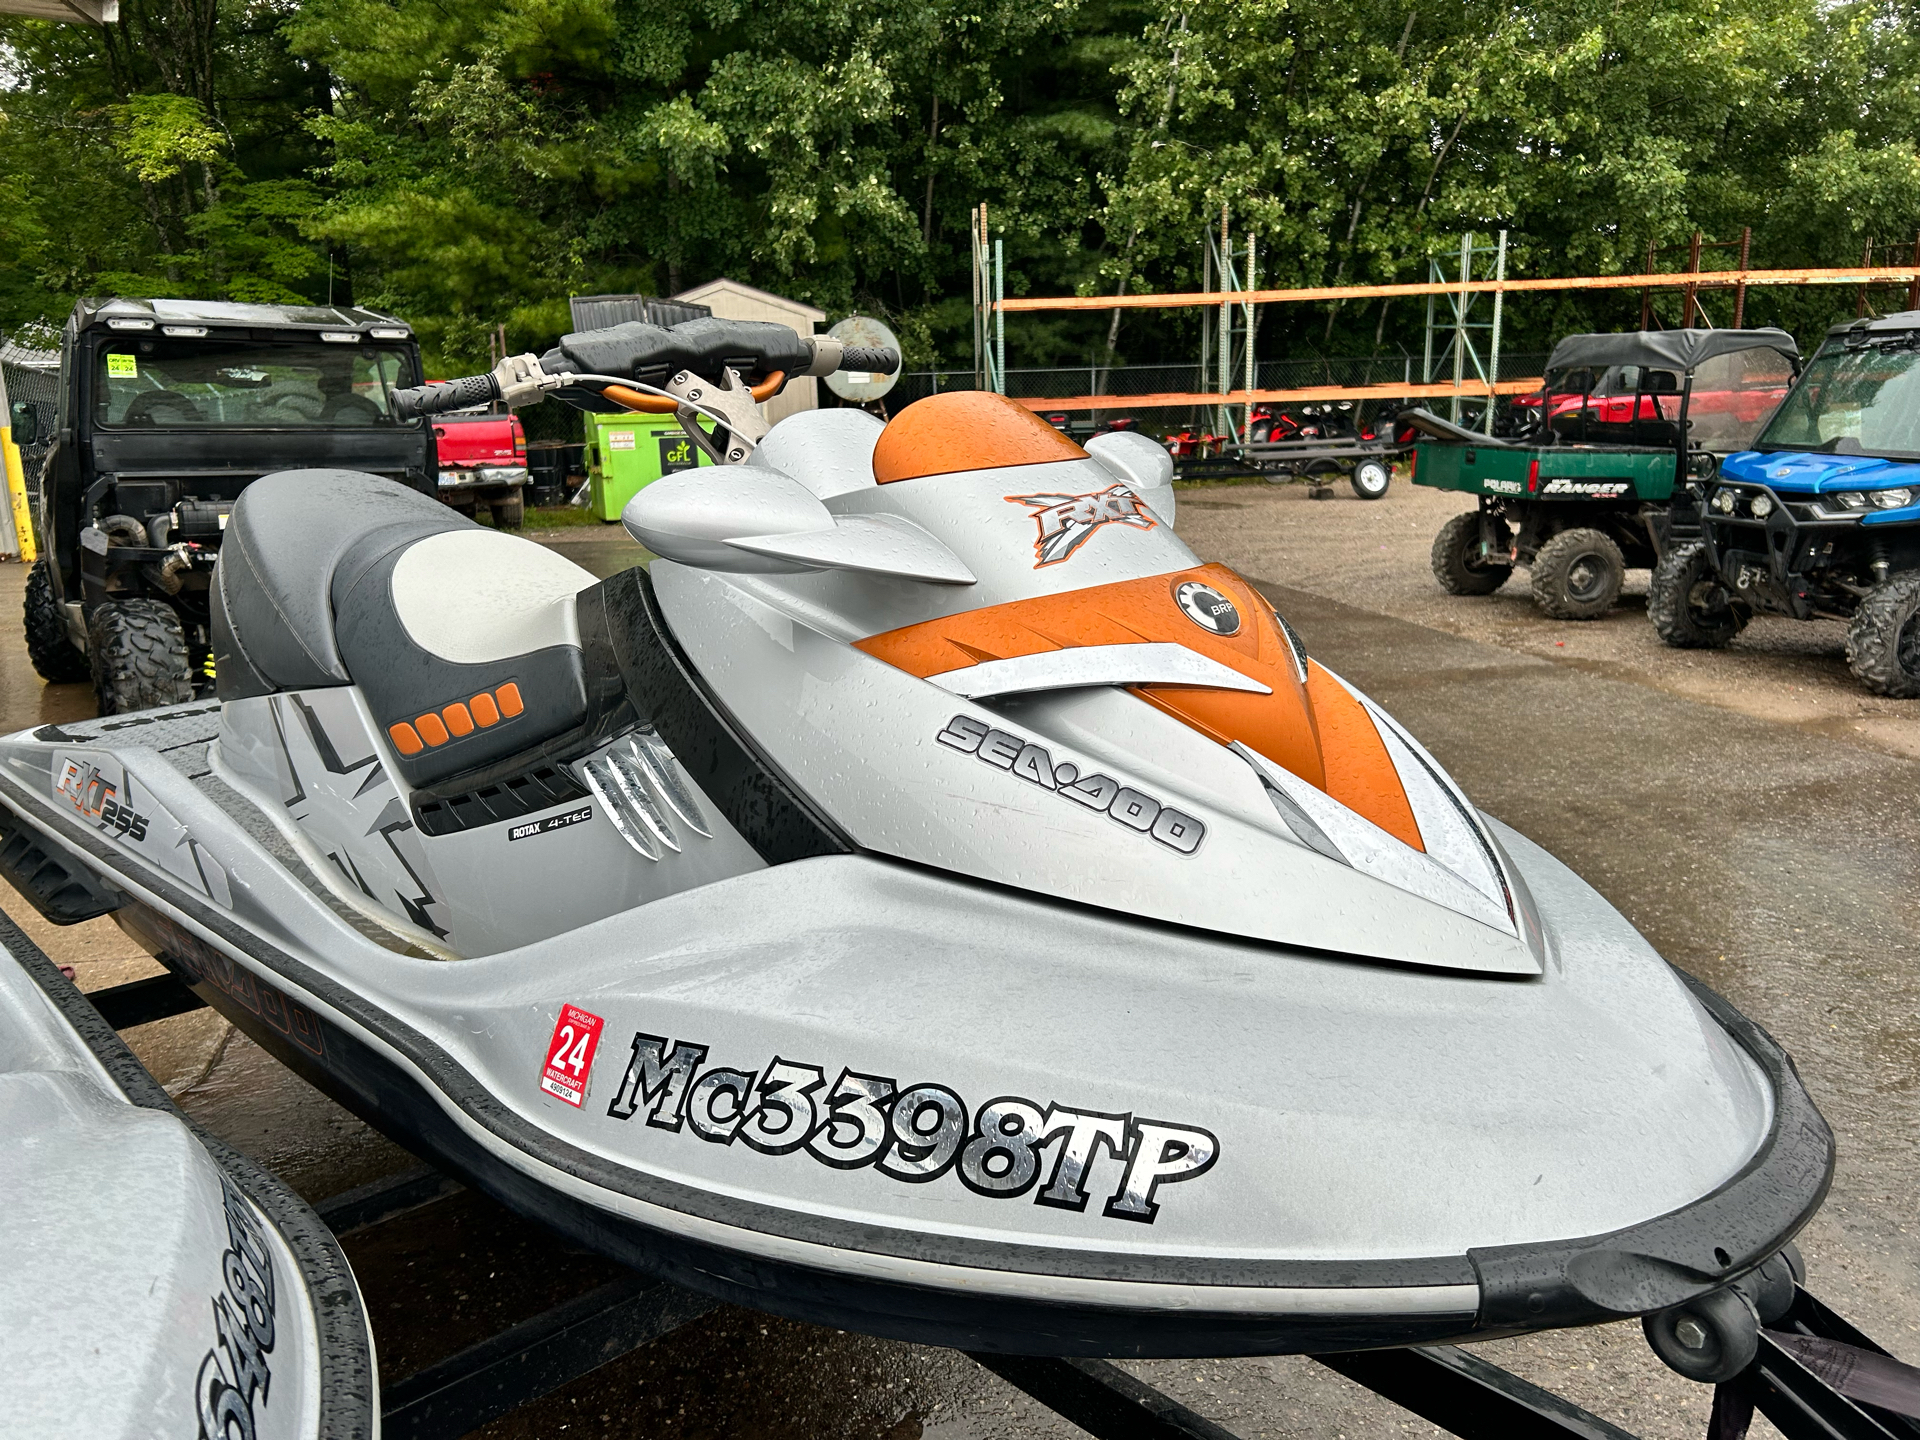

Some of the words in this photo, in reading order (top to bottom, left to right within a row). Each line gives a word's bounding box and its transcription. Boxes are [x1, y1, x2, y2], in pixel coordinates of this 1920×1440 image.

[667, 444, 691, 462] GFL
[1542, 482, 1630, 494] RANGER
[1210, 602, 1233, 617] BRP
[56, 757, 117, 817] RXT
[101, 798, 150, 842] 255
[513, 822, 541, 839] ROTAX
[548, 809, 591, 828] 4-TEC
[567, 1009, 597, 1027] MICHIGAN
[551, 1025, 590, 1077] 24
[546, 1067, 582, 1090] WATERCRAFT
[550, 1081, 573, 1099] 4909124
